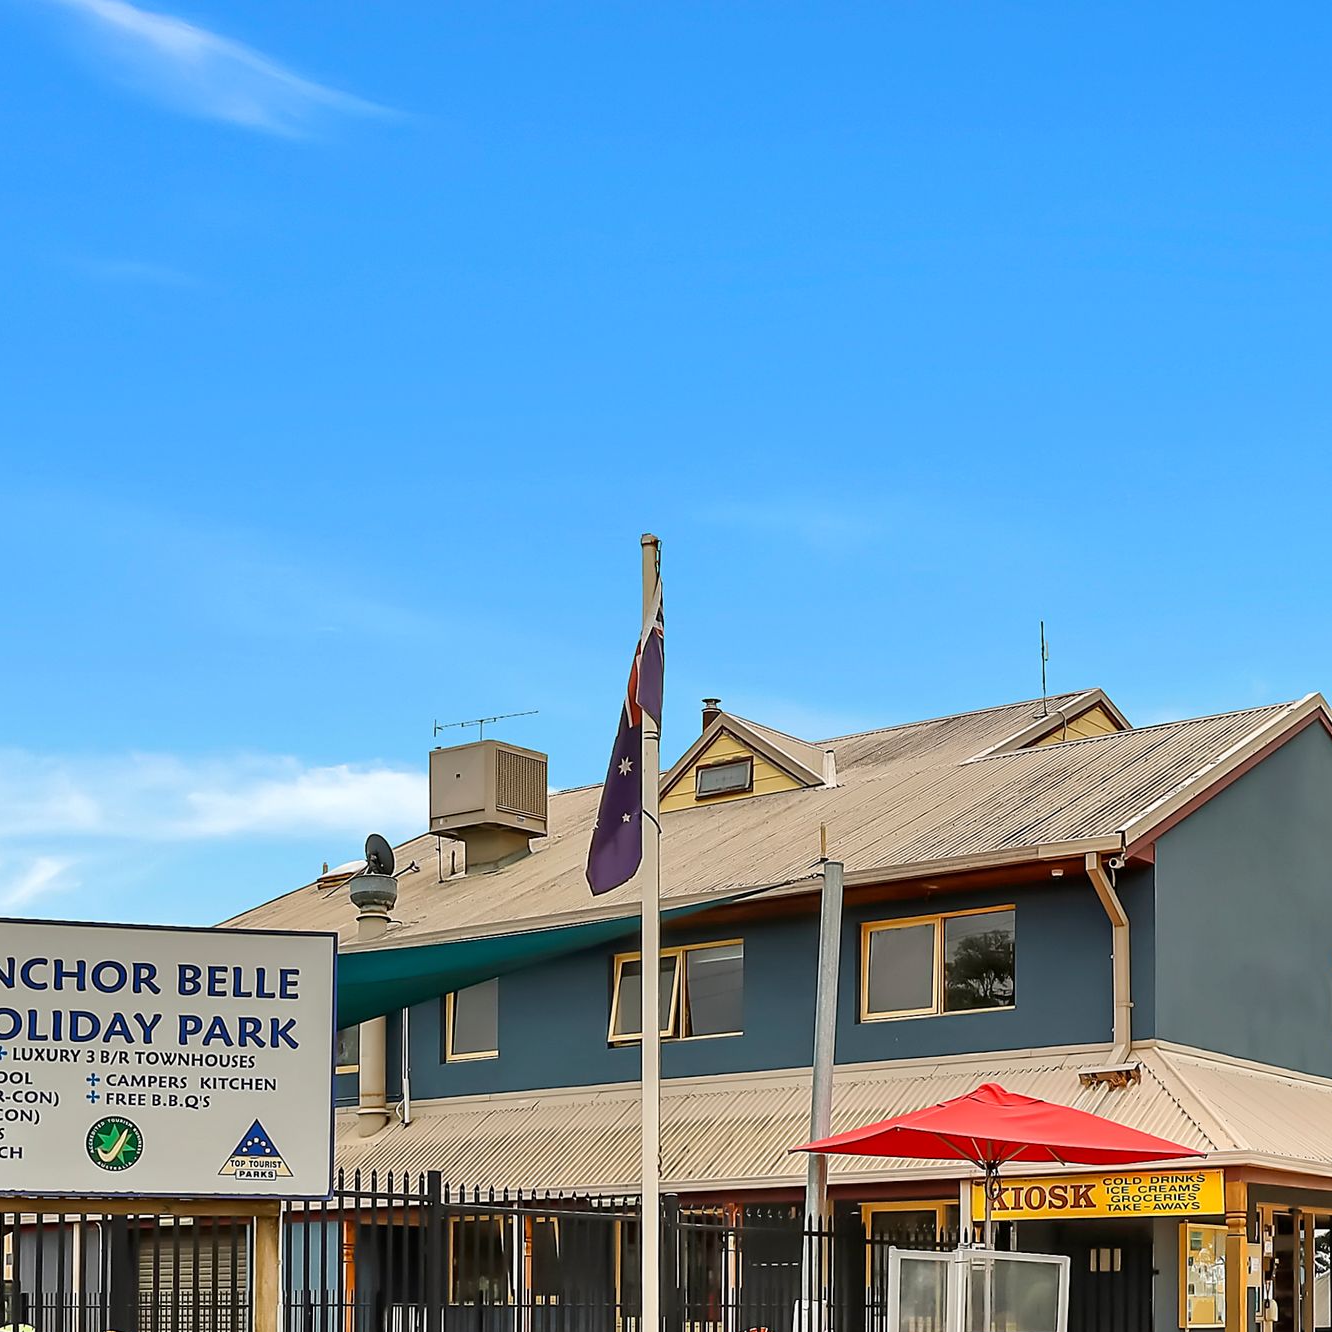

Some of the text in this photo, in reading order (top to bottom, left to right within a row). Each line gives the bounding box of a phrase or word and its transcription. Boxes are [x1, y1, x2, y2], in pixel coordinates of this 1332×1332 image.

[177, 963, 300, 1000] BELLE
[178, 1014, 300, 1050] PARK
[12, 1048, 256, 1069] LUXURY 3 B/R TOWNHOUSES
[106, 1074, 277, 1091] CAMPERS KITCHEN
[106, 1093, 210, 1109] FREE B.B.Q'S
[230, 1160, 282, 1168] TOP TOURIST
[239, 1170, 274, 1178] PARKS
[1103, 1174, 1206, 1186] COLD DRINKS
[991, 1184, 1097, 1211] KIOSK
[1106, 1184, 1201, 1195] ICE CREAMS
[1111, 1193, 1197, 1203] GROCERIES
